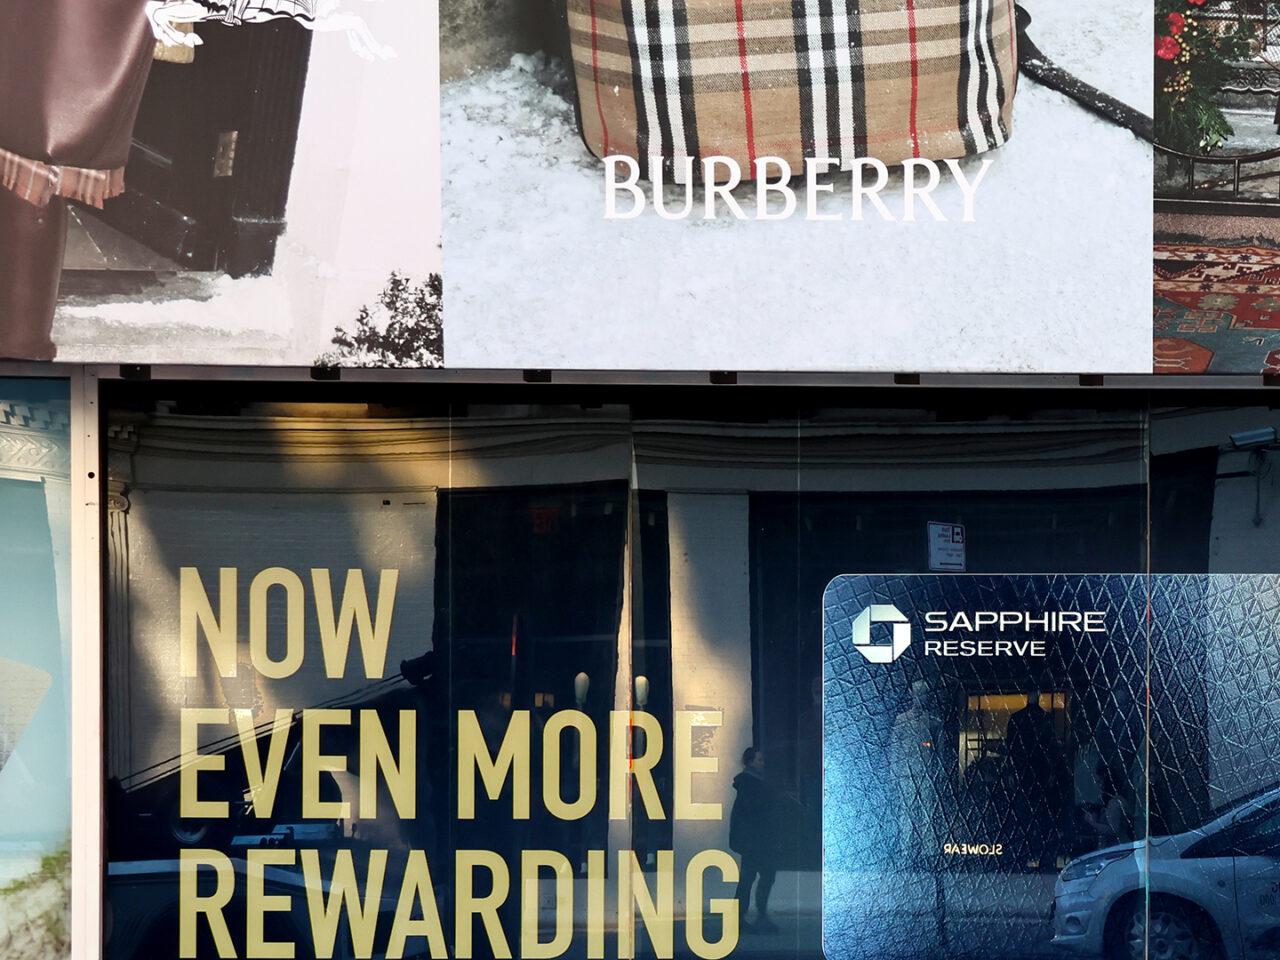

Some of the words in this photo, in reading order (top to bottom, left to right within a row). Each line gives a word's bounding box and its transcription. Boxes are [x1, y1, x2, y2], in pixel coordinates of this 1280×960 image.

[601, 154, 995, 223] BURBERRY
[179, 566, 399, 680] NOW
[924, 611, 1107, 633] SAPPHIRE
[924, 640, 1047, 657] RESERVE
[179, 709, 417, 821] EVEN
[457, 709, 724, 822] MORE
[179, 848, 741, 960] REWARDING
